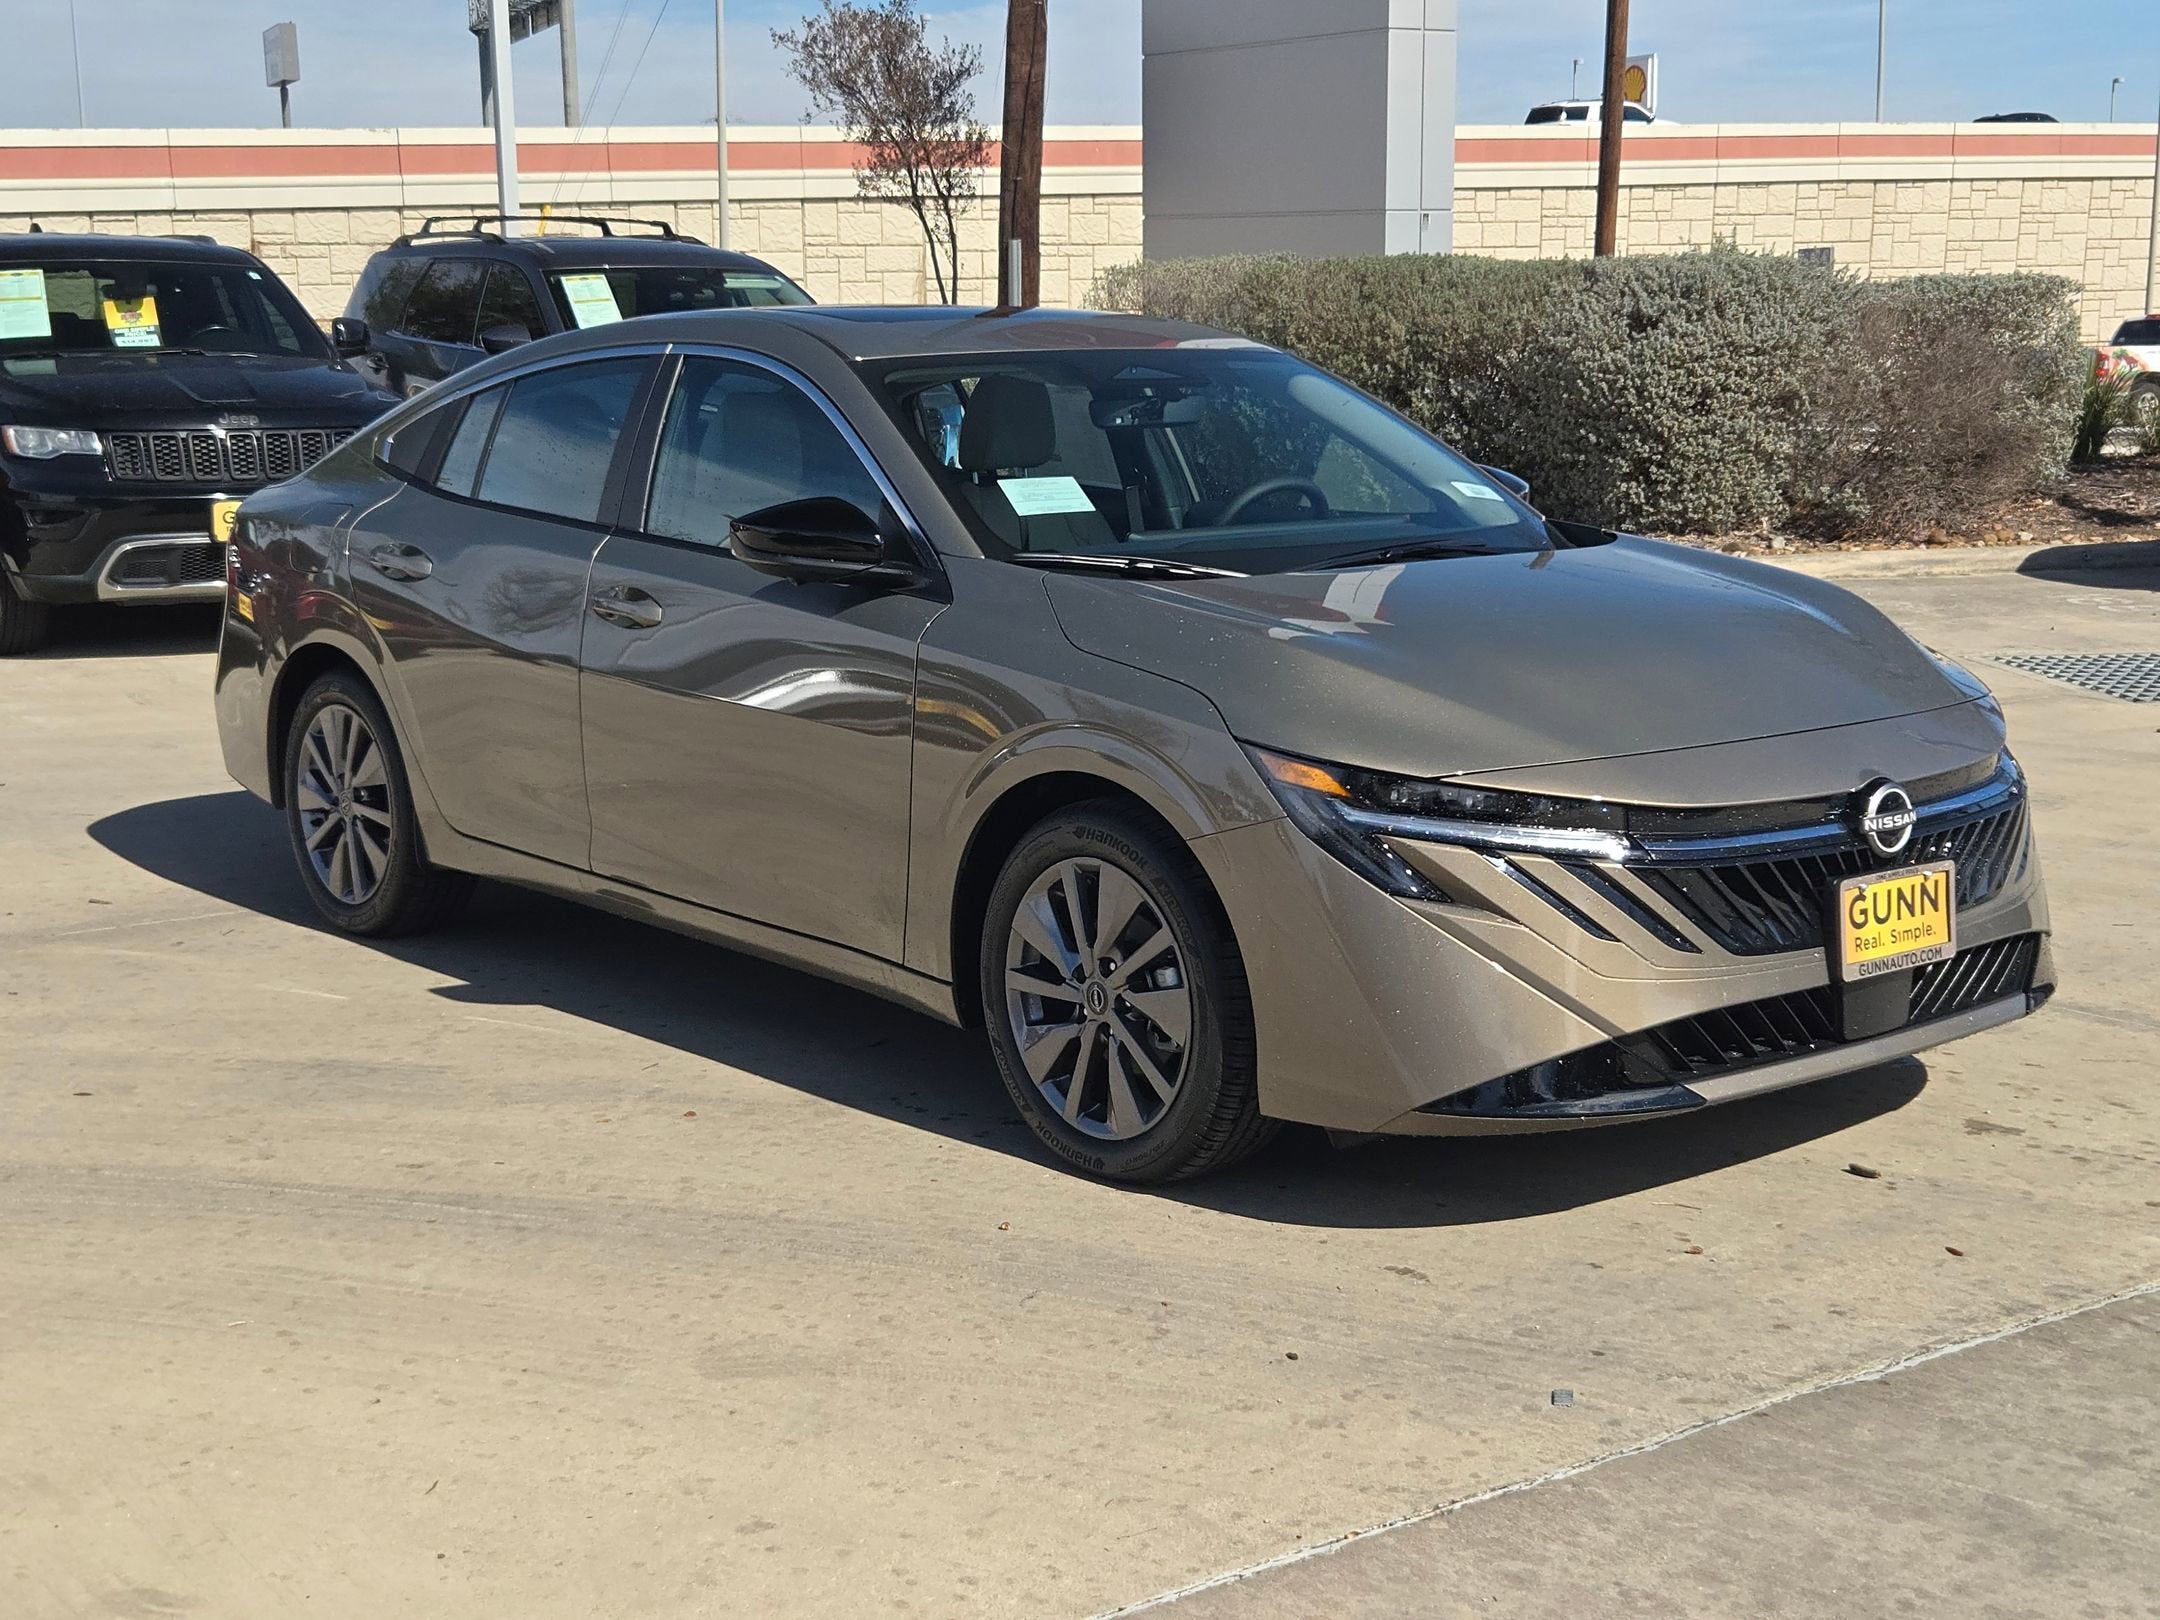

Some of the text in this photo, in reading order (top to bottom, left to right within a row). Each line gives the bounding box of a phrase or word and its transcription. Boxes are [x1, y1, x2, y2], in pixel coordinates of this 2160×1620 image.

[219, 412, 260, 426] Jeep
[1864, 810, 1917, 831] NISSAN
[1849, 879, 1939, 930] GUNN
[1855, 922, 1937, 952] Real. Simple.
[1859, 946, 1943, 976] GUNNAUTO.COM
